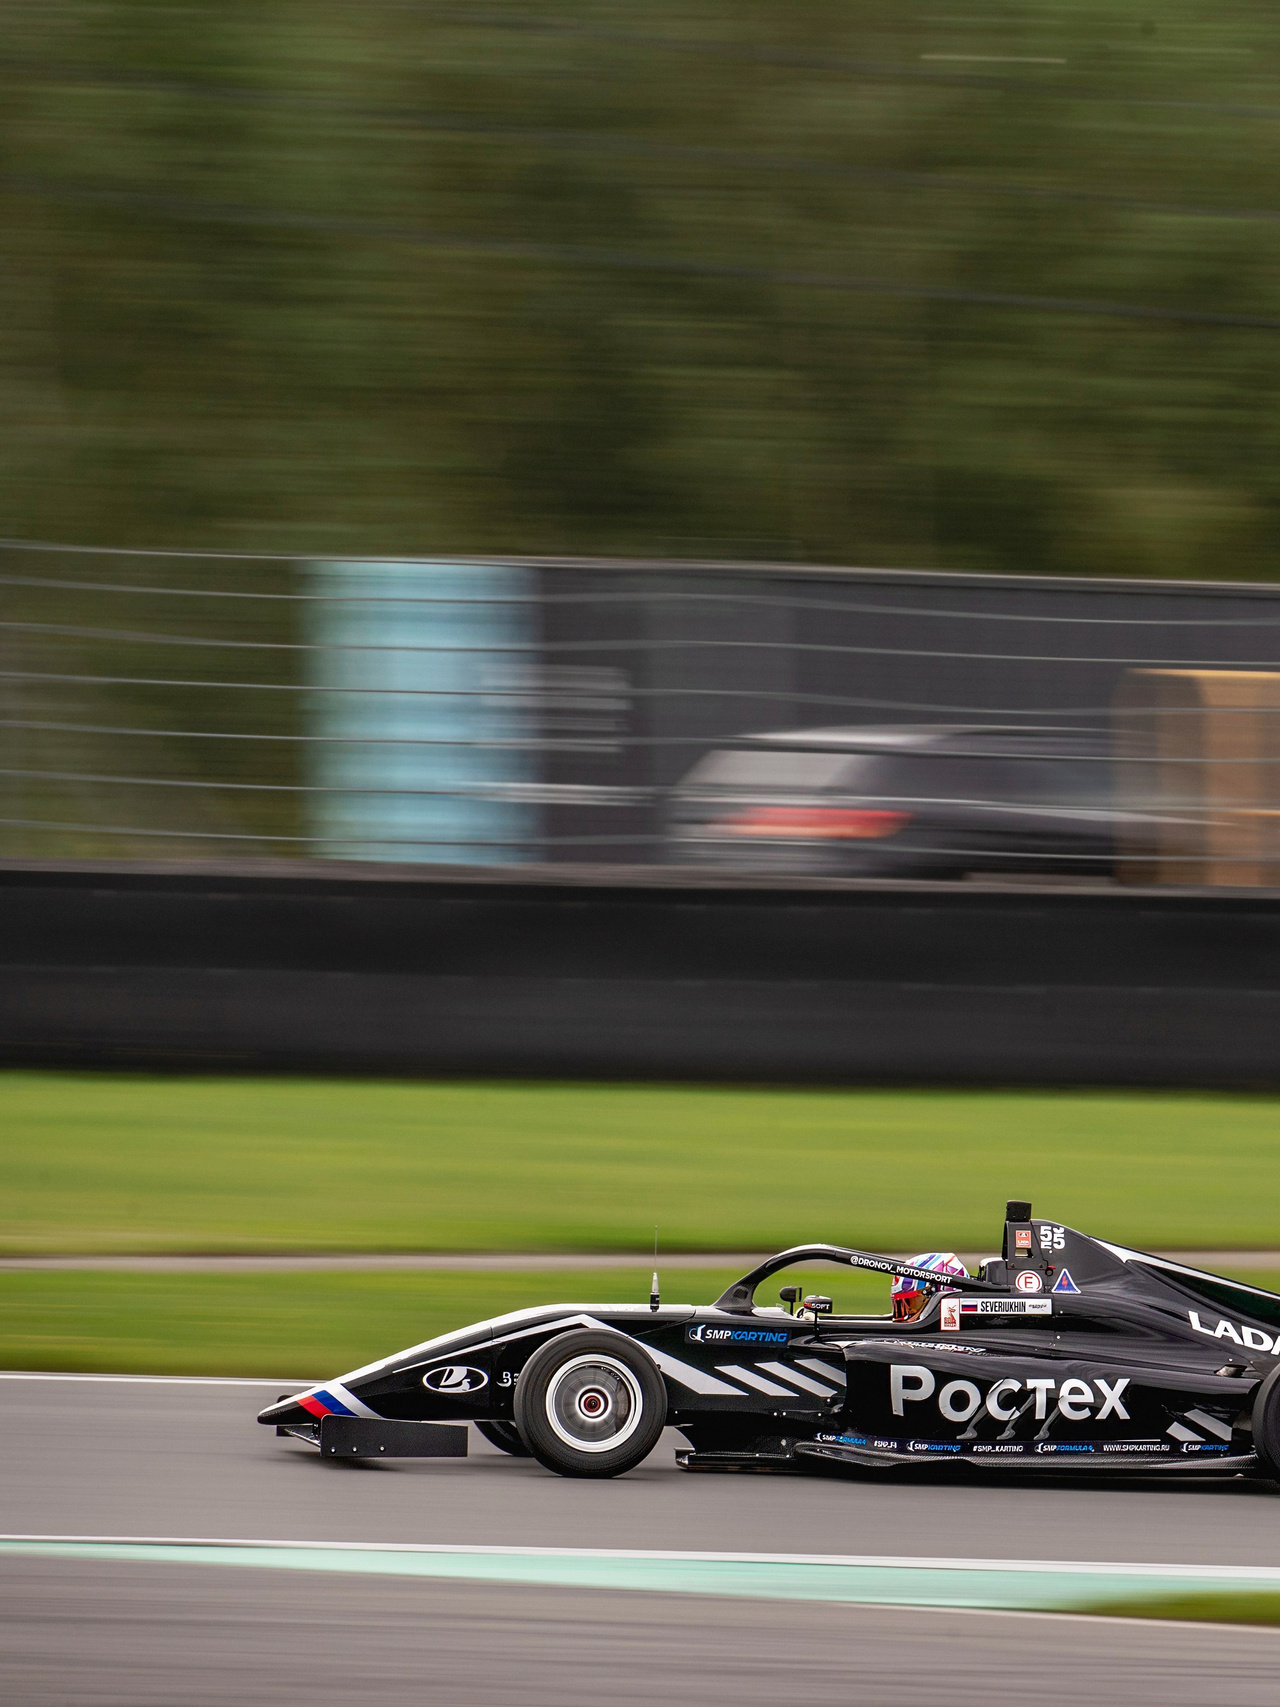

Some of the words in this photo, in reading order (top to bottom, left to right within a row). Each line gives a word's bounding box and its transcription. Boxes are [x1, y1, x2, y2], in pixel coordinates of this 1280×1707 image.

[850, 1255, 953, 1285] @DRONOV_MOTORSPORT
[1024, 1276, 1034, 1289] E
[980, 1301, 1026, 1313] SEVERIUKHIN
[705, 1329, 788, 1343] SMPKARTING
[890, 1364, 1131, 1422] Ростех
[914, 1444, 961, 1452] SMPKARTING
[973, 1445, 1024, 1453] #SMP_KARTING
[1103, 1444, 1170, 1452] WWW.SMPKARTING.RU
